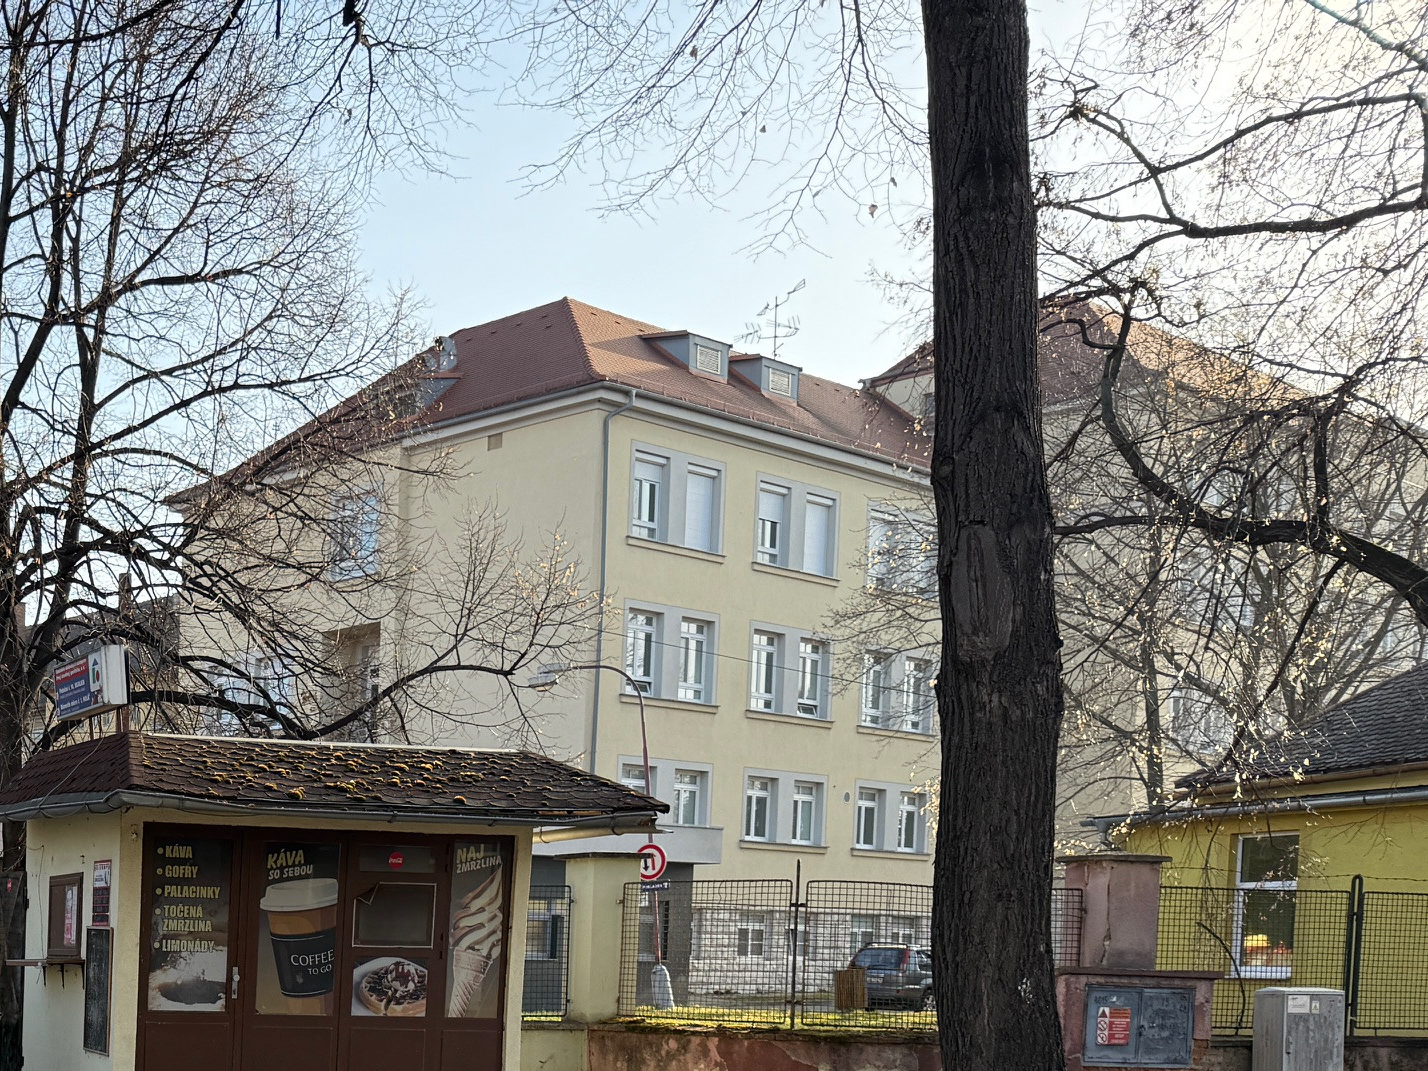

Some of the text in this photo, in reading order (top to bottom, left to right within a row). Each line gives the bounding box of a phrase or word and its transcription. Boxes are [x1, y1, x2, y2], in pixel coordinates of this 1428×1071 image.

[165, 844, 193, 858] KÁVA
[456, 844, 485, 863] NAJ
[267, 848, 304, 869] KÁVA
[456, 855, 502, 874] ZMRZLINA
[165, 865, 198, 878] GOFRY
[268, 865, 313, 880] SO SEBOU
[164, 885, 220, 898] PALACINKY
[164, 904, 203, 918] TOČENÁ
[162, 919, 212, 932] ZMRZLINA
[162, 938, 214, 953] LIMONÁDY
[290, 949, 335, 966] COFFEE
[308, 964, 332, 975] TO GO
